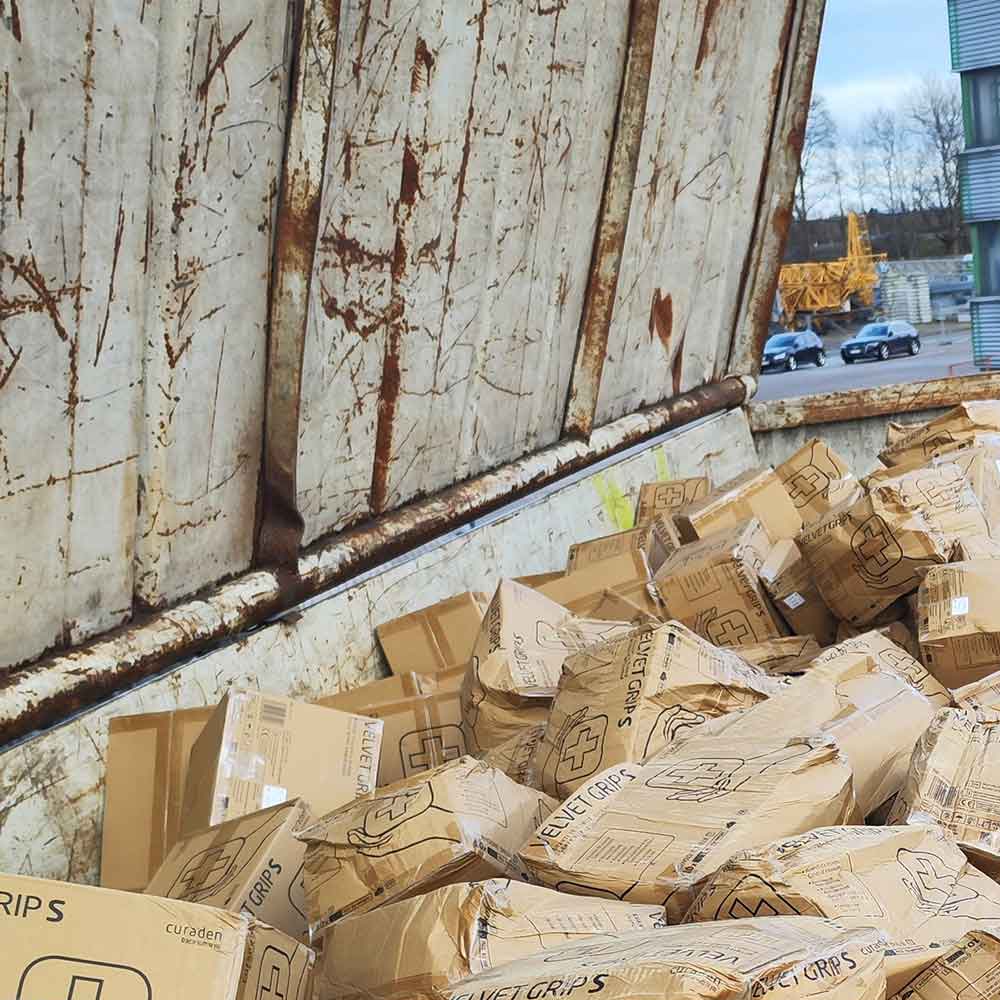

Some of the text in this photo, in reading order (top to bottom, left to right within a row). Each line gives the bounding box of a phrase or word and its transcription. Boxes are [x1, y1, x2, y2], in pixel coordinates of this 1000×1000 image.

[618, 632, 653, 728] ELVET GRIPS
[588, 768, 637, 801] GRIPS
[249, 858, 282, 909] GRIPS
[165, 920, 224, 942] curaden
[803, 951, 857, 981] GRIPS
[526, 974, 609, 1000] GRIPS
